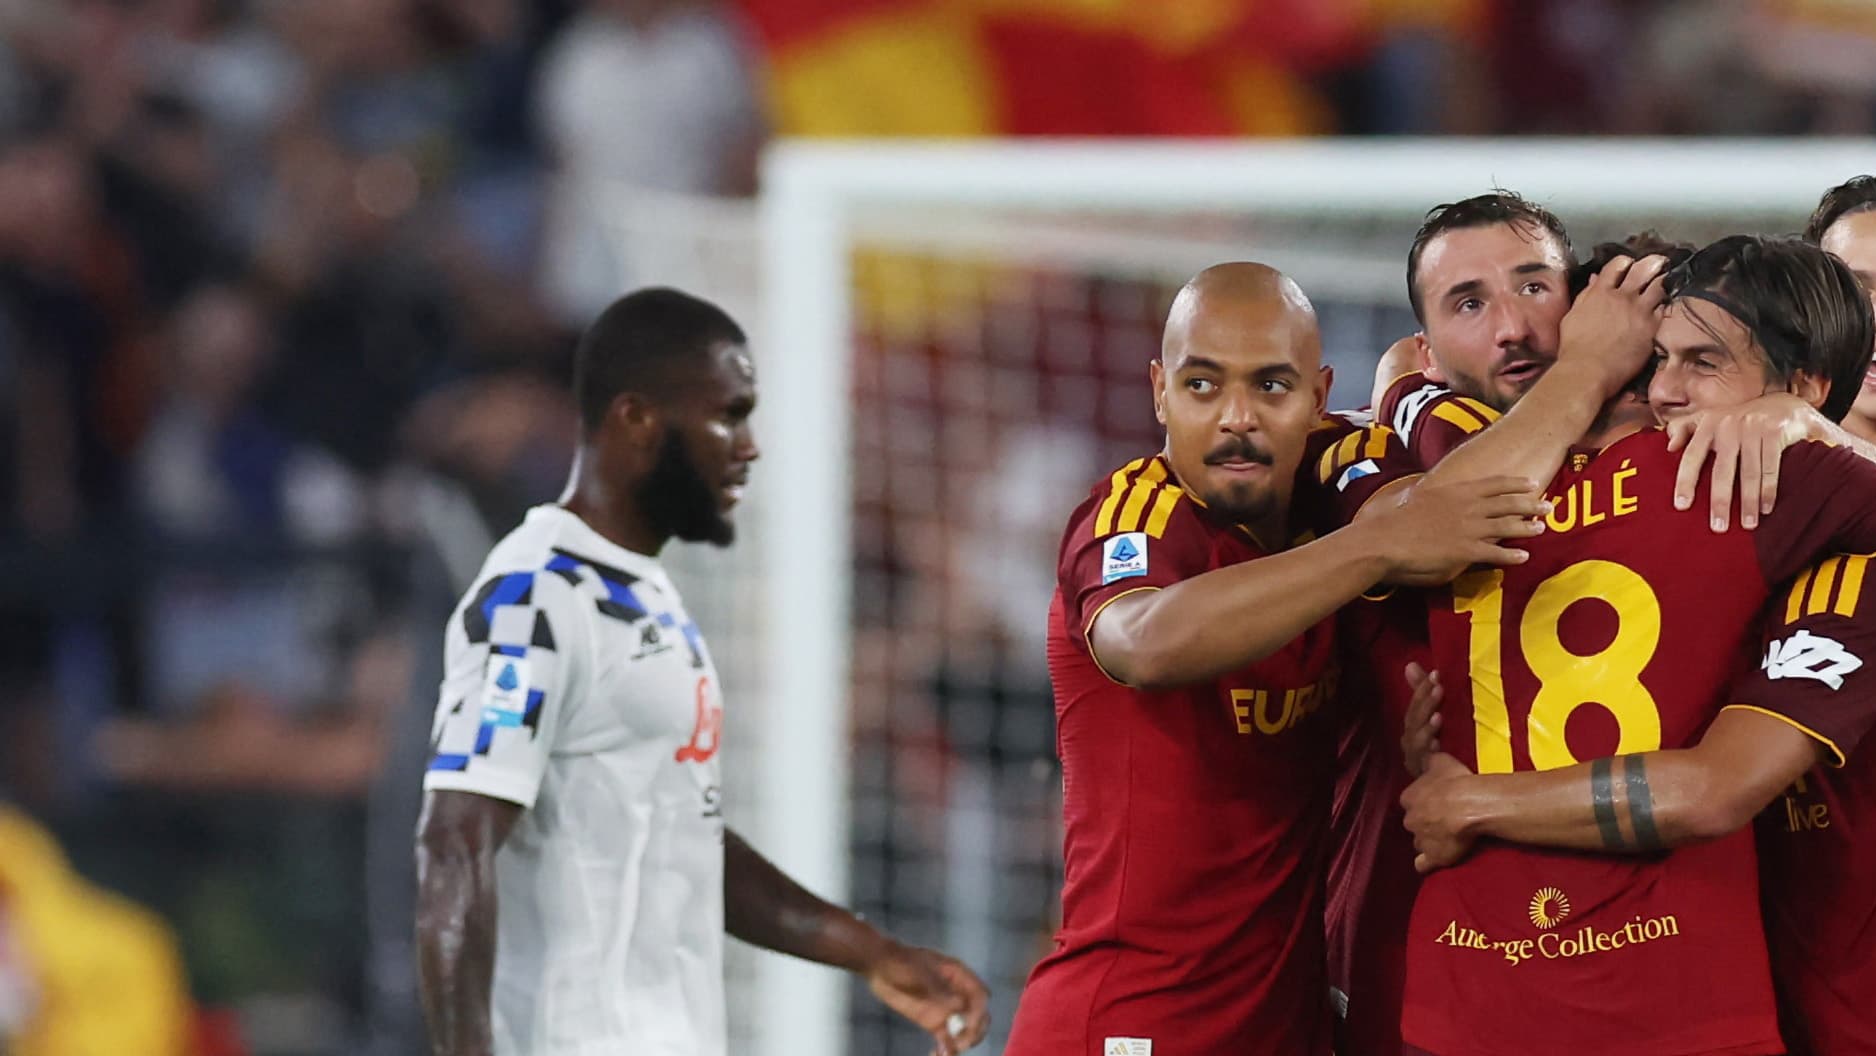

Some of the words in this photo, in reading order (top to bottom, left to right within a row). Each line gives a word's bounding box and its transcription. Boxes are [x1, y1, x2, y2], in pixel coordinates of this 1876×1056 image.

[1532, 458, 1638, 533] ULÉ
[1453, 559, 1662, 775] 18
[1537, 914, 1681, 960] Collection
